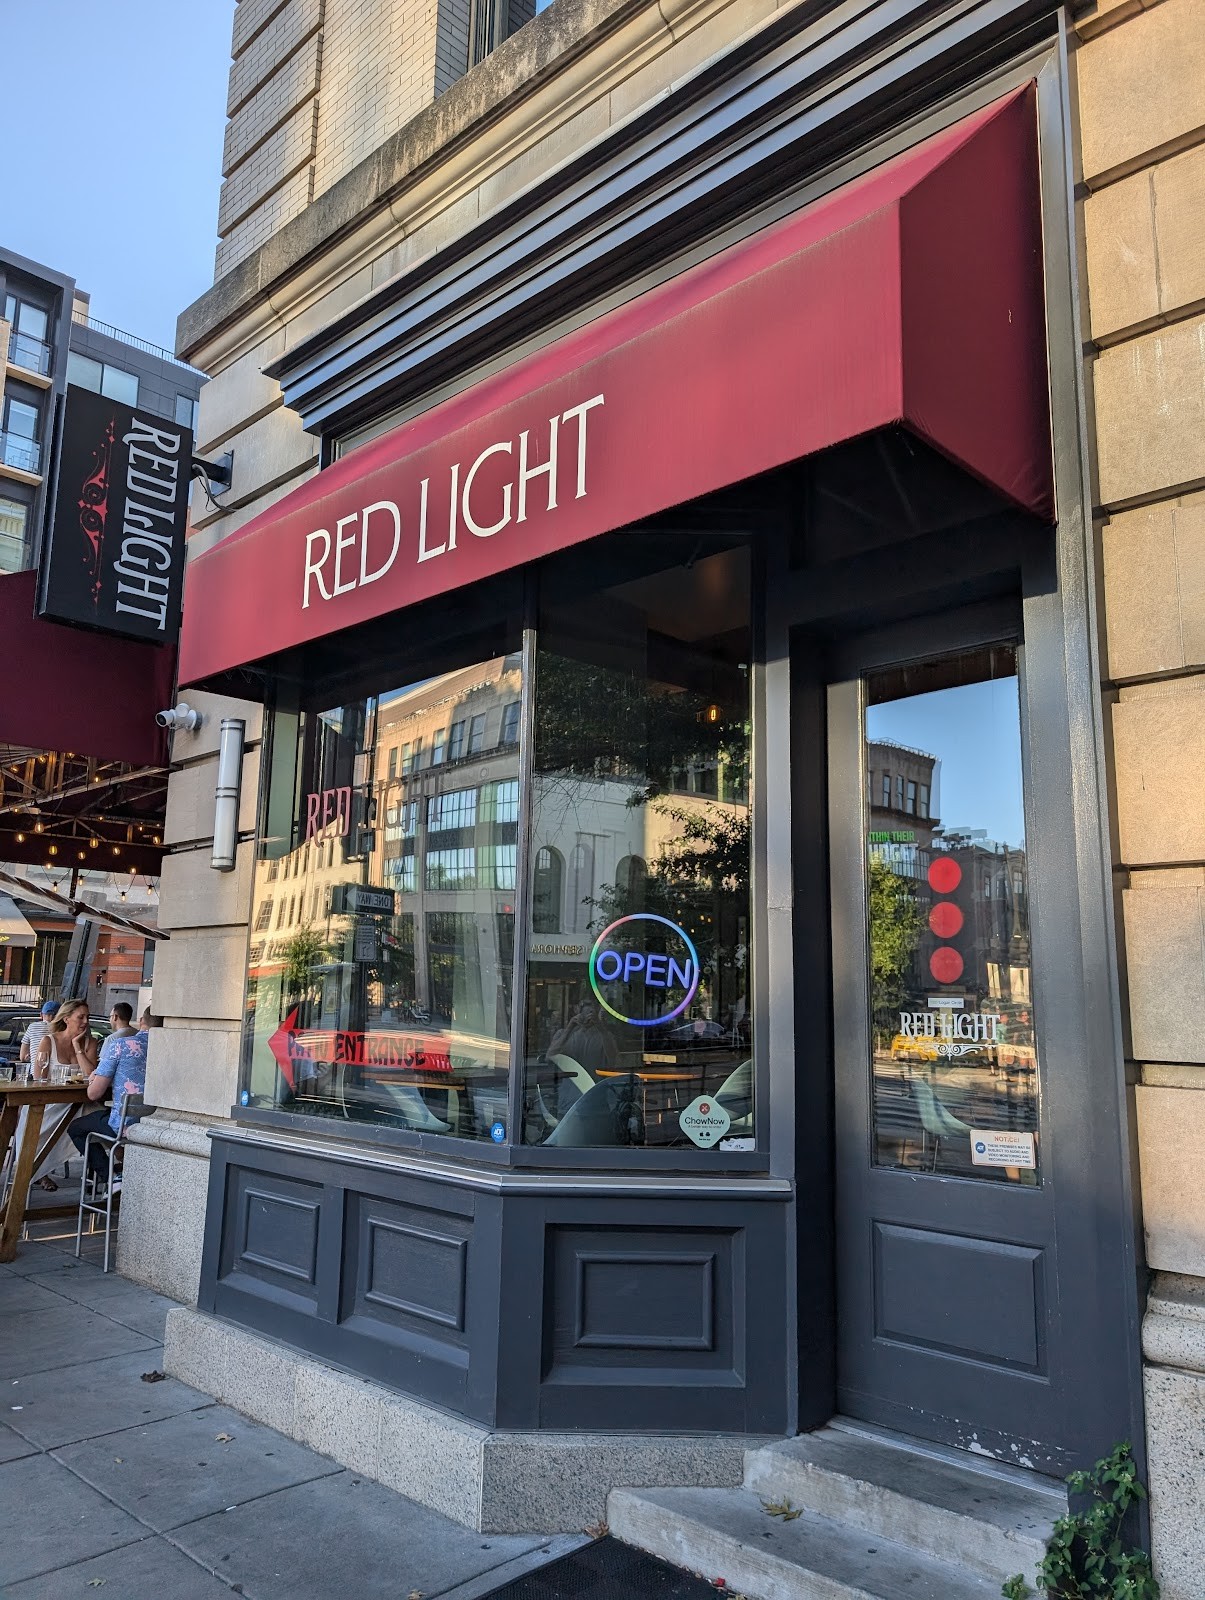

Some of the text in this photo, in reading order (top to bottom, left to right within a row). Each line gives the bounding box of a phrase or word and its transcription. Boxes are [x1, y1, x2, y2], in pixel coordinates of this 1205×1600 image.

[302, 393, 605, 609] RED LIGHT
[113, 417, 181, 630] RED LIGHT
[305, 772, 442, 848] RED LIGHT
[892, 830, 915, 842] THEIR
[596, 950, 692, 989] OPEN
[899, 1012, 1000, 1042] RED LIGHT
[335, 1033, 426, 1067] ENTRANCE
